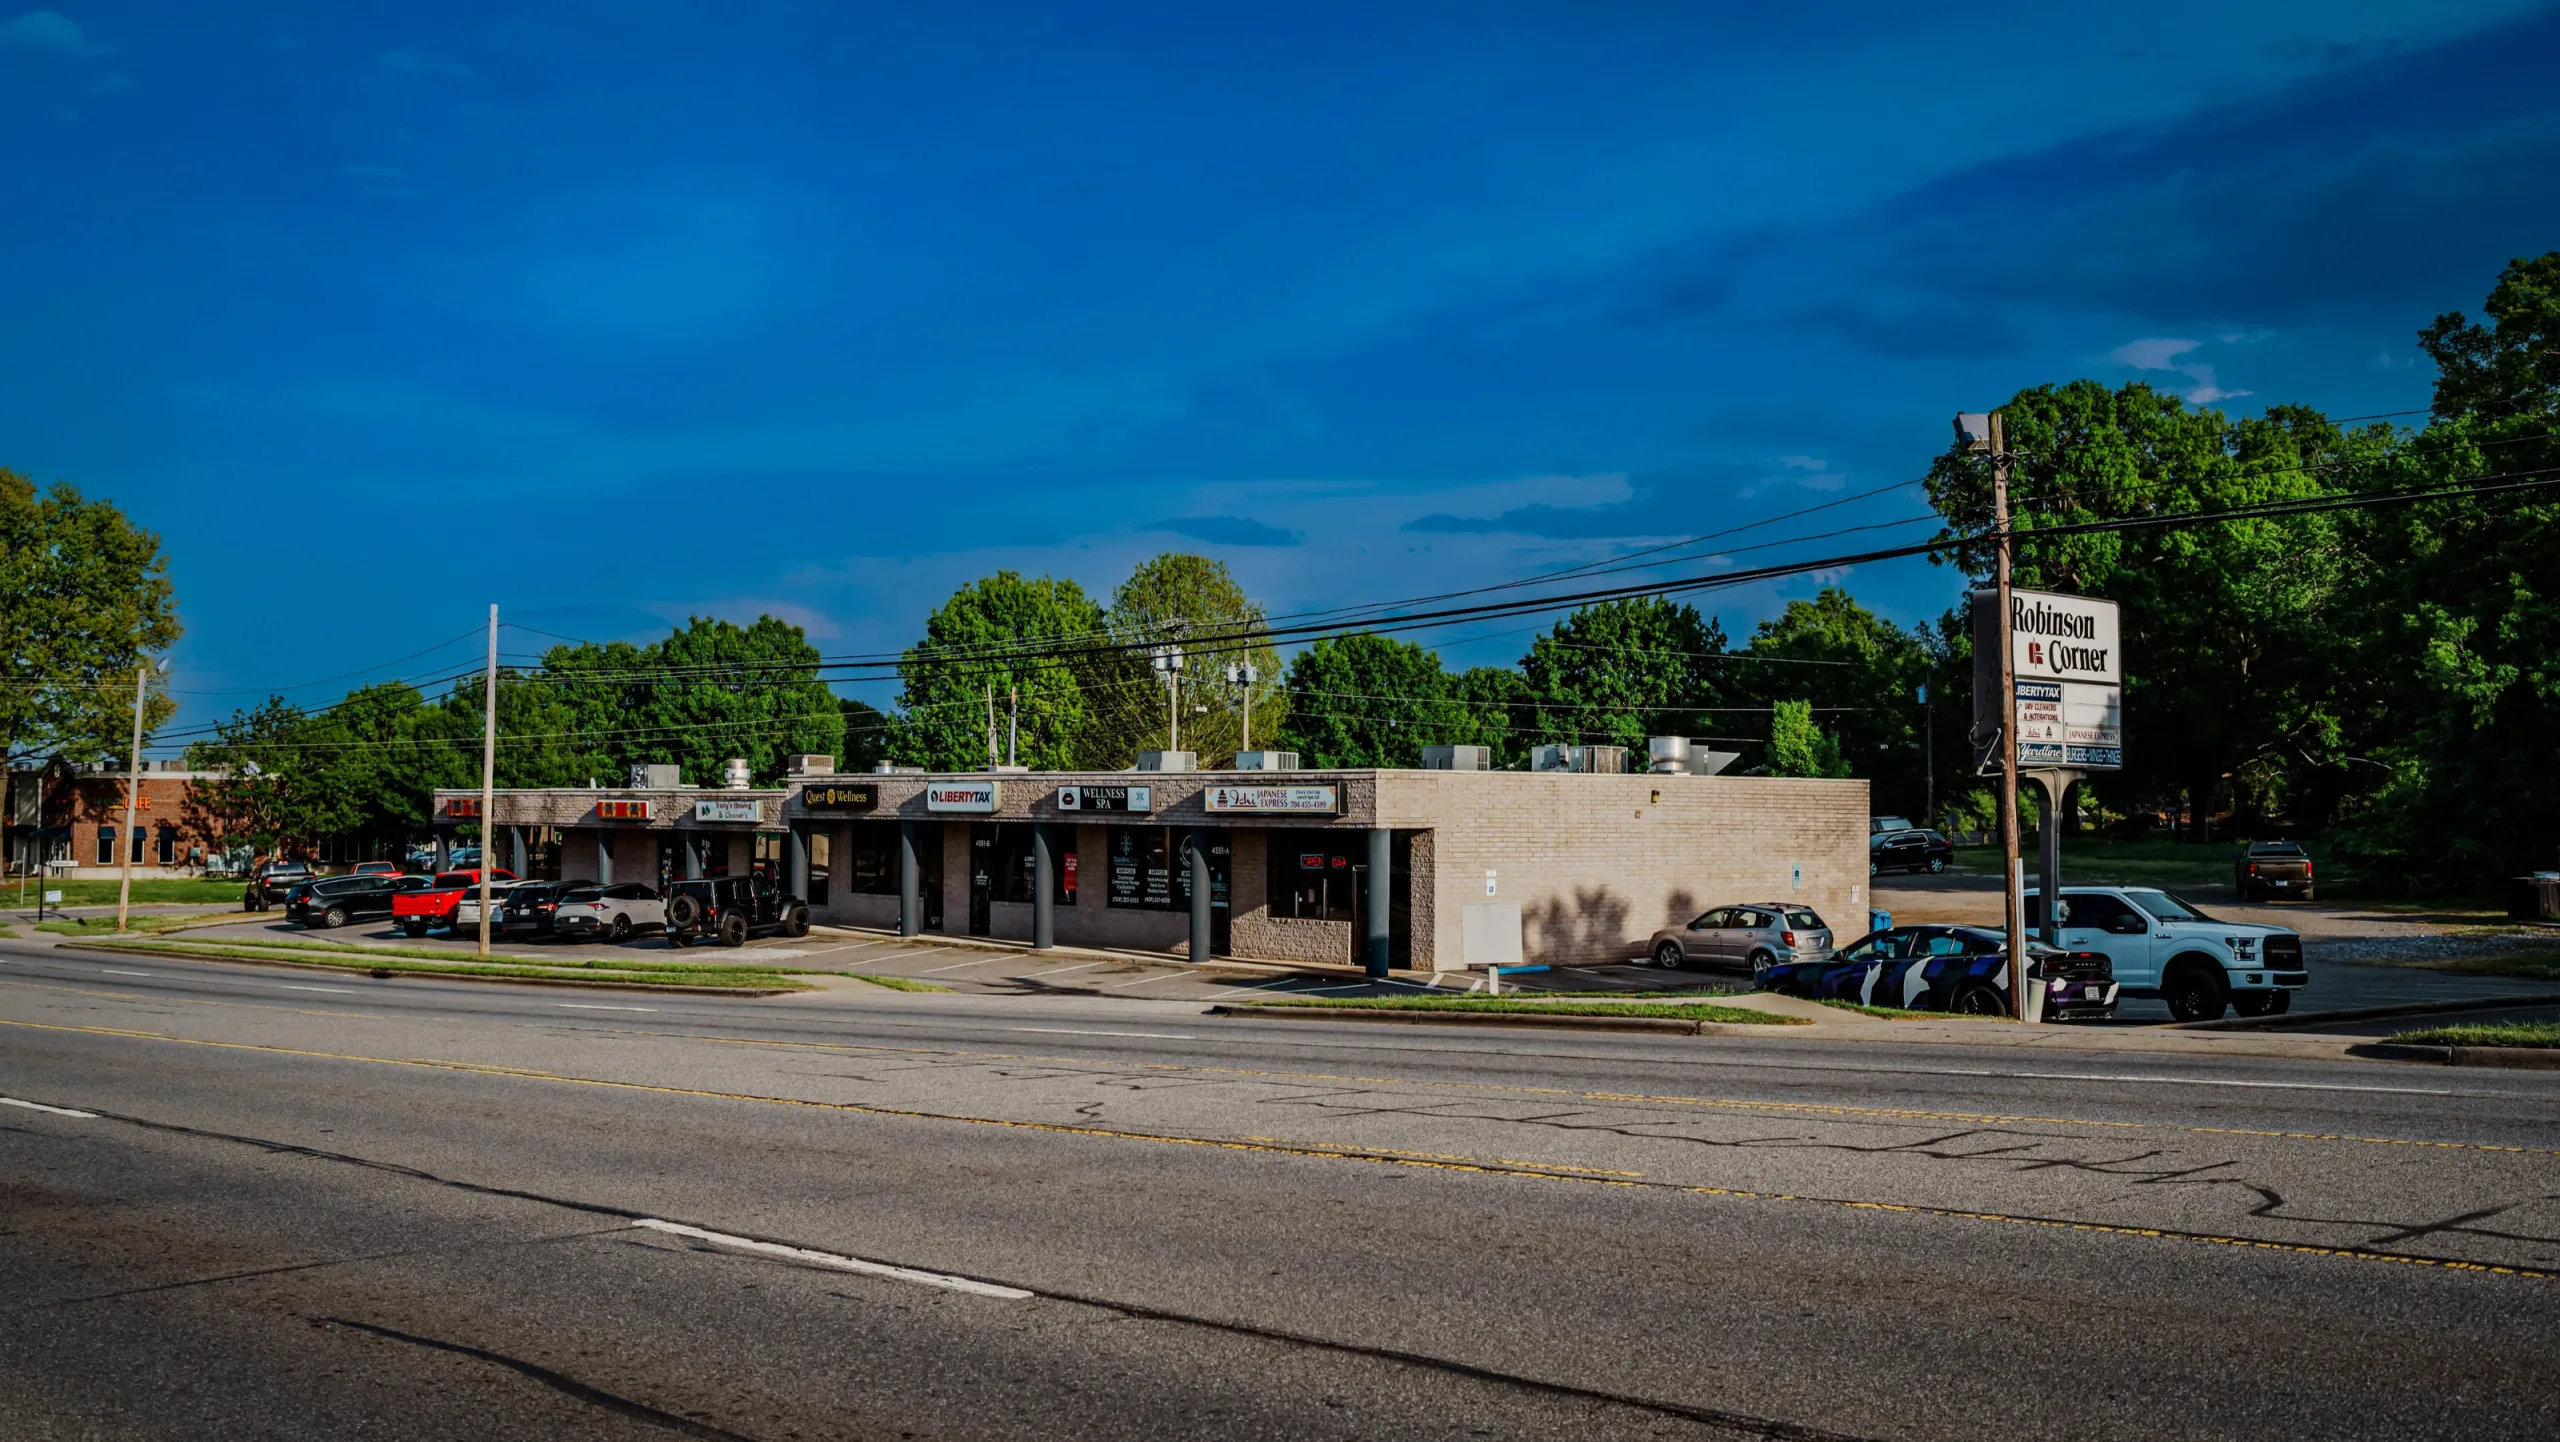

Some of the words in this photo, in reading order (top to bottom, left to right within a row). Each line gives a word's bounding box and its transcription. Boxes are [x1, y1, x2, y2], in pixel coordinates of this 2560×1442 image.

[2012, 596, 2095, 639] Robinson
[2049, 640, 2108, 674] Corner
[2015, 685, 2060, 698] IBERTYTAX
[2069, 731, 2093, 739] JAPANESE
[2094, 731, 2116, 741] EXPRESS
[2021, 743, 2062, 761] Yardline
[2067, 747, 2087, 761] BURGERS
[2089, 749, 2104, 762] WINGS
[2106, 751, 2121, 763] THINGS
[805, 790, 826, 804] Quest
[836, 790, 867, 802] Wellness
[939, 791, 990, 803] LIBERTYTAX
[1083, 788, 1125, 798] WELLNESS
[1229, 789, 1257, 805] Ichi
[1257, 789, 1288, 799] JAPANESE
[1096, 799, 1111, 809] SPA
[1260, 799, 1288, 808] EXPRESS
[1303, 856, 1324, 867] OPEN
